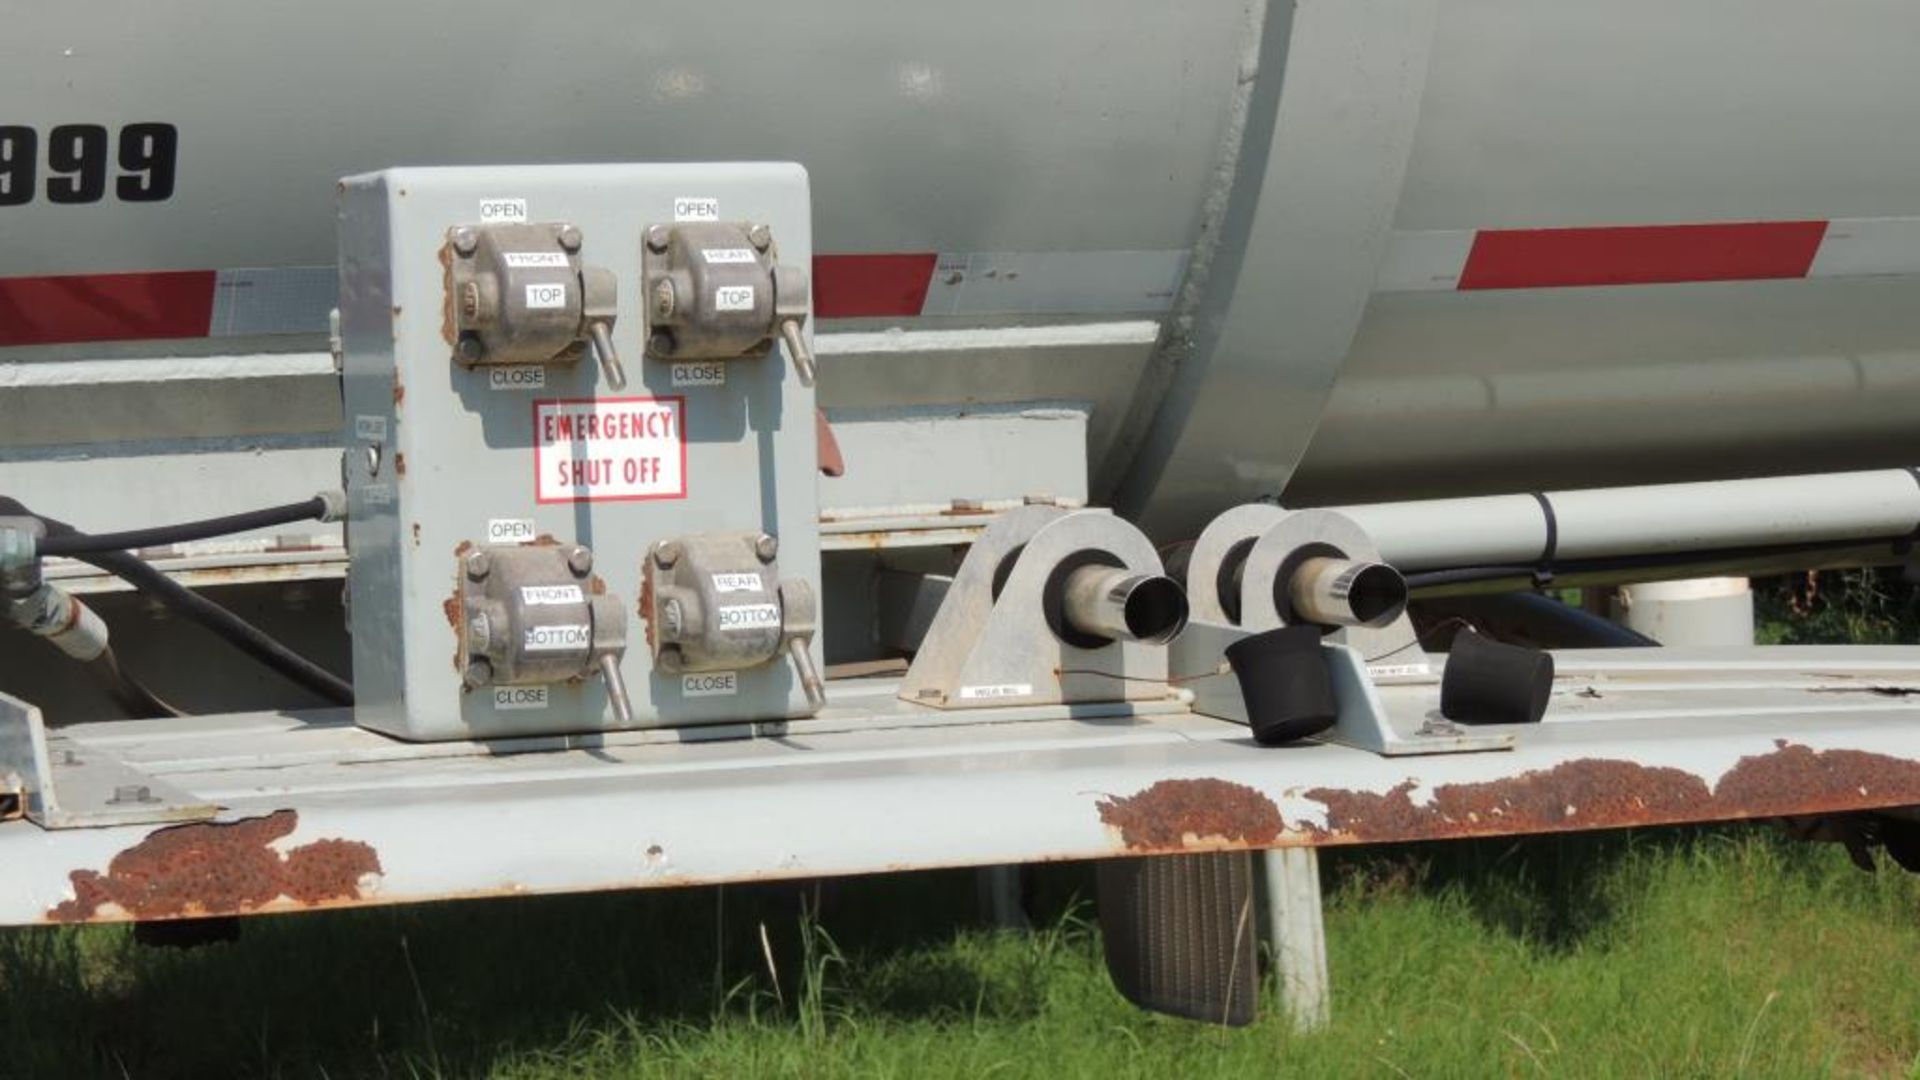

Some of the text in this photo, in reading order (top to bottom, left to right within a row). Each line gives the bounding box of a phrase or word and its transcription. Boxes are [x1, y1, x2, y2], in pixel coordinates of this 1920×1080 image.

[0, 122, 178, 207] 999
[481, 203, 525, 218] OPEN
[674, 202, 717, 217] OPEN
[509, 253, 562, 264] FRONT
[707, 249, 750, 261] REAR
[531, 288, 563, 302] TOP
[720, 291, 750, 305] TOP
[492, 370, 544, 385] CLOSE
[674, 366, 724, 381] CLOSE
[543, 411, 673, 442] EMERGENCY
[557, 456, 661, 487] SHUT OFF
[490, 523, 533, 538] OPEN
[716, 576, 759, 588] REAR
[526, 588, 577, 600] FRONT
[525, 629, 590, 645] BOTTOM
[685, 676, 735, 691] CLOSE
[496, 689, 546, 704] CLOSE
